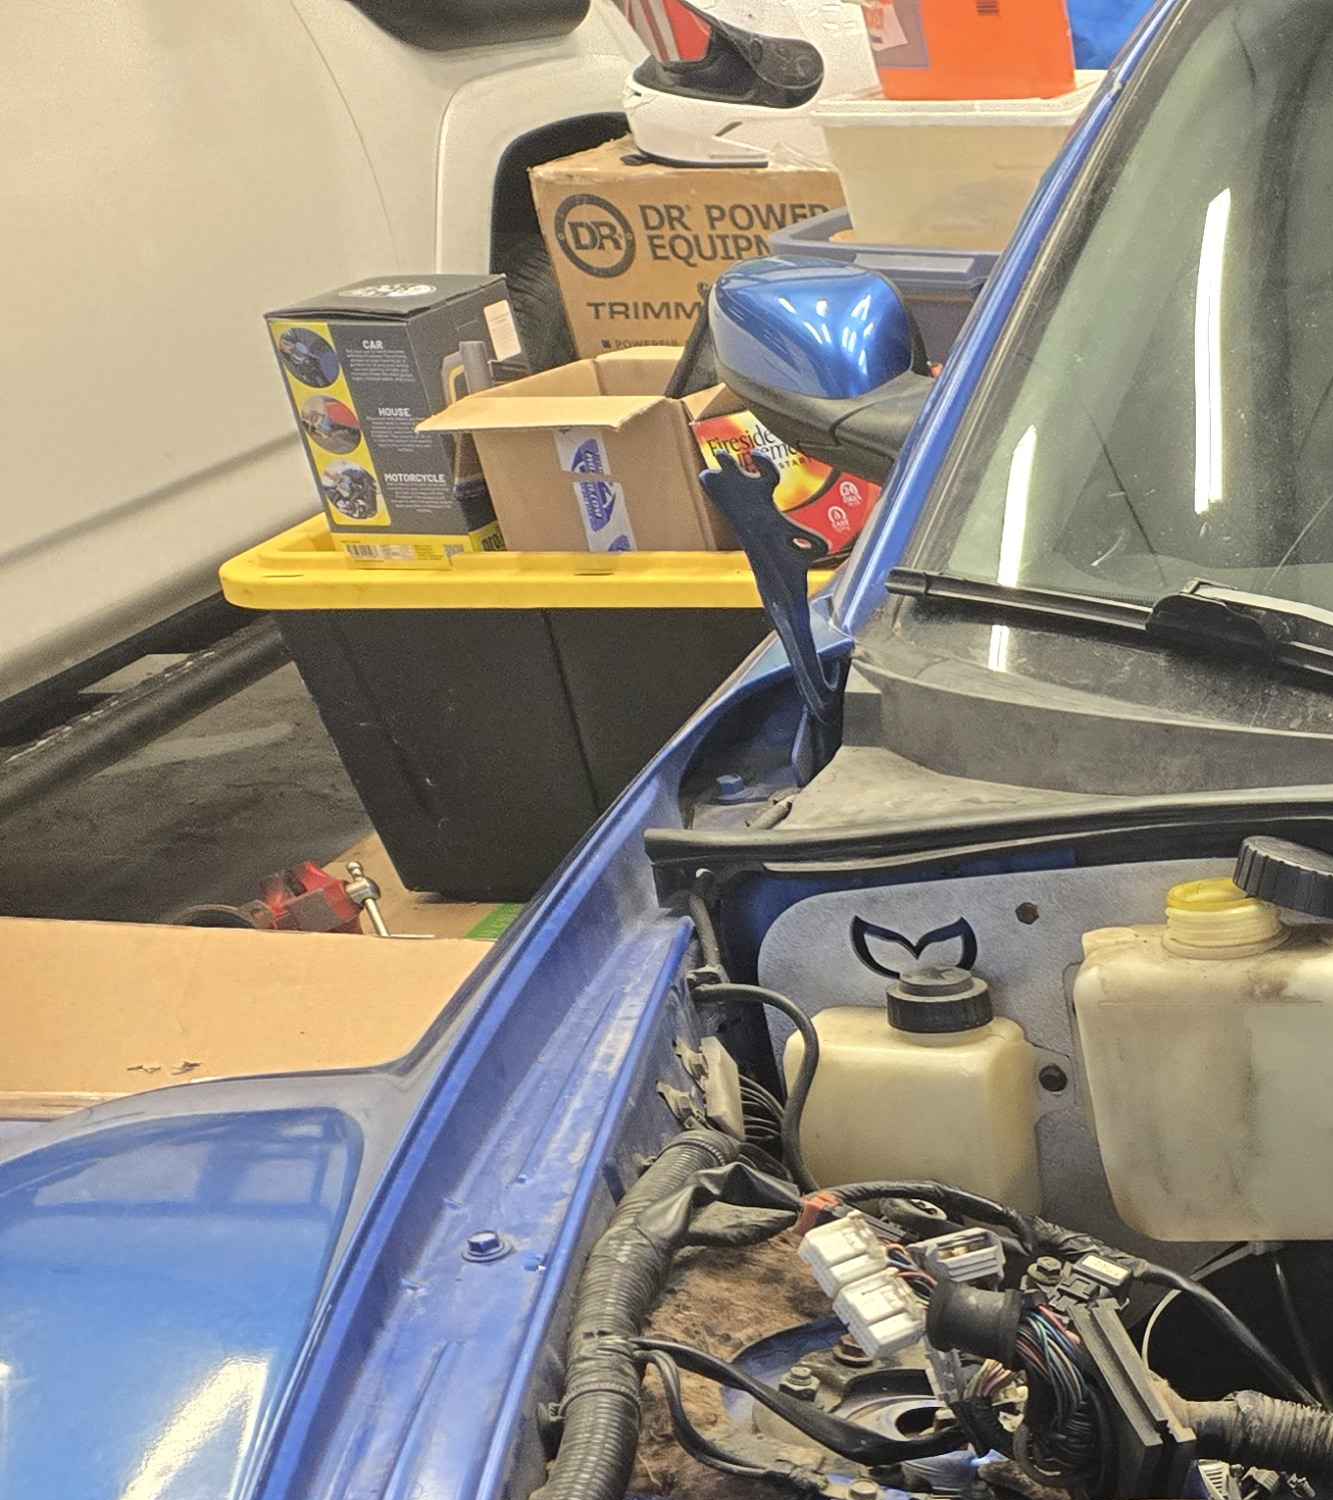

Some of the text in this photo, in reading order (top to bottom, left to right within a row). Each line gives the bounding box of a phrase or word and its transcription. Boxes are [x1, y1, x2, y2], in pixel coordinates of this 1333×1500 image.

[638, 204, 692, 231] DR
[567, 221, 622, 251] DR
[362, 339, 384, 350] CAR
[378, 407, 411, 417] HOUSE
[384, 473, 447, 483] MOTORCYCLE
